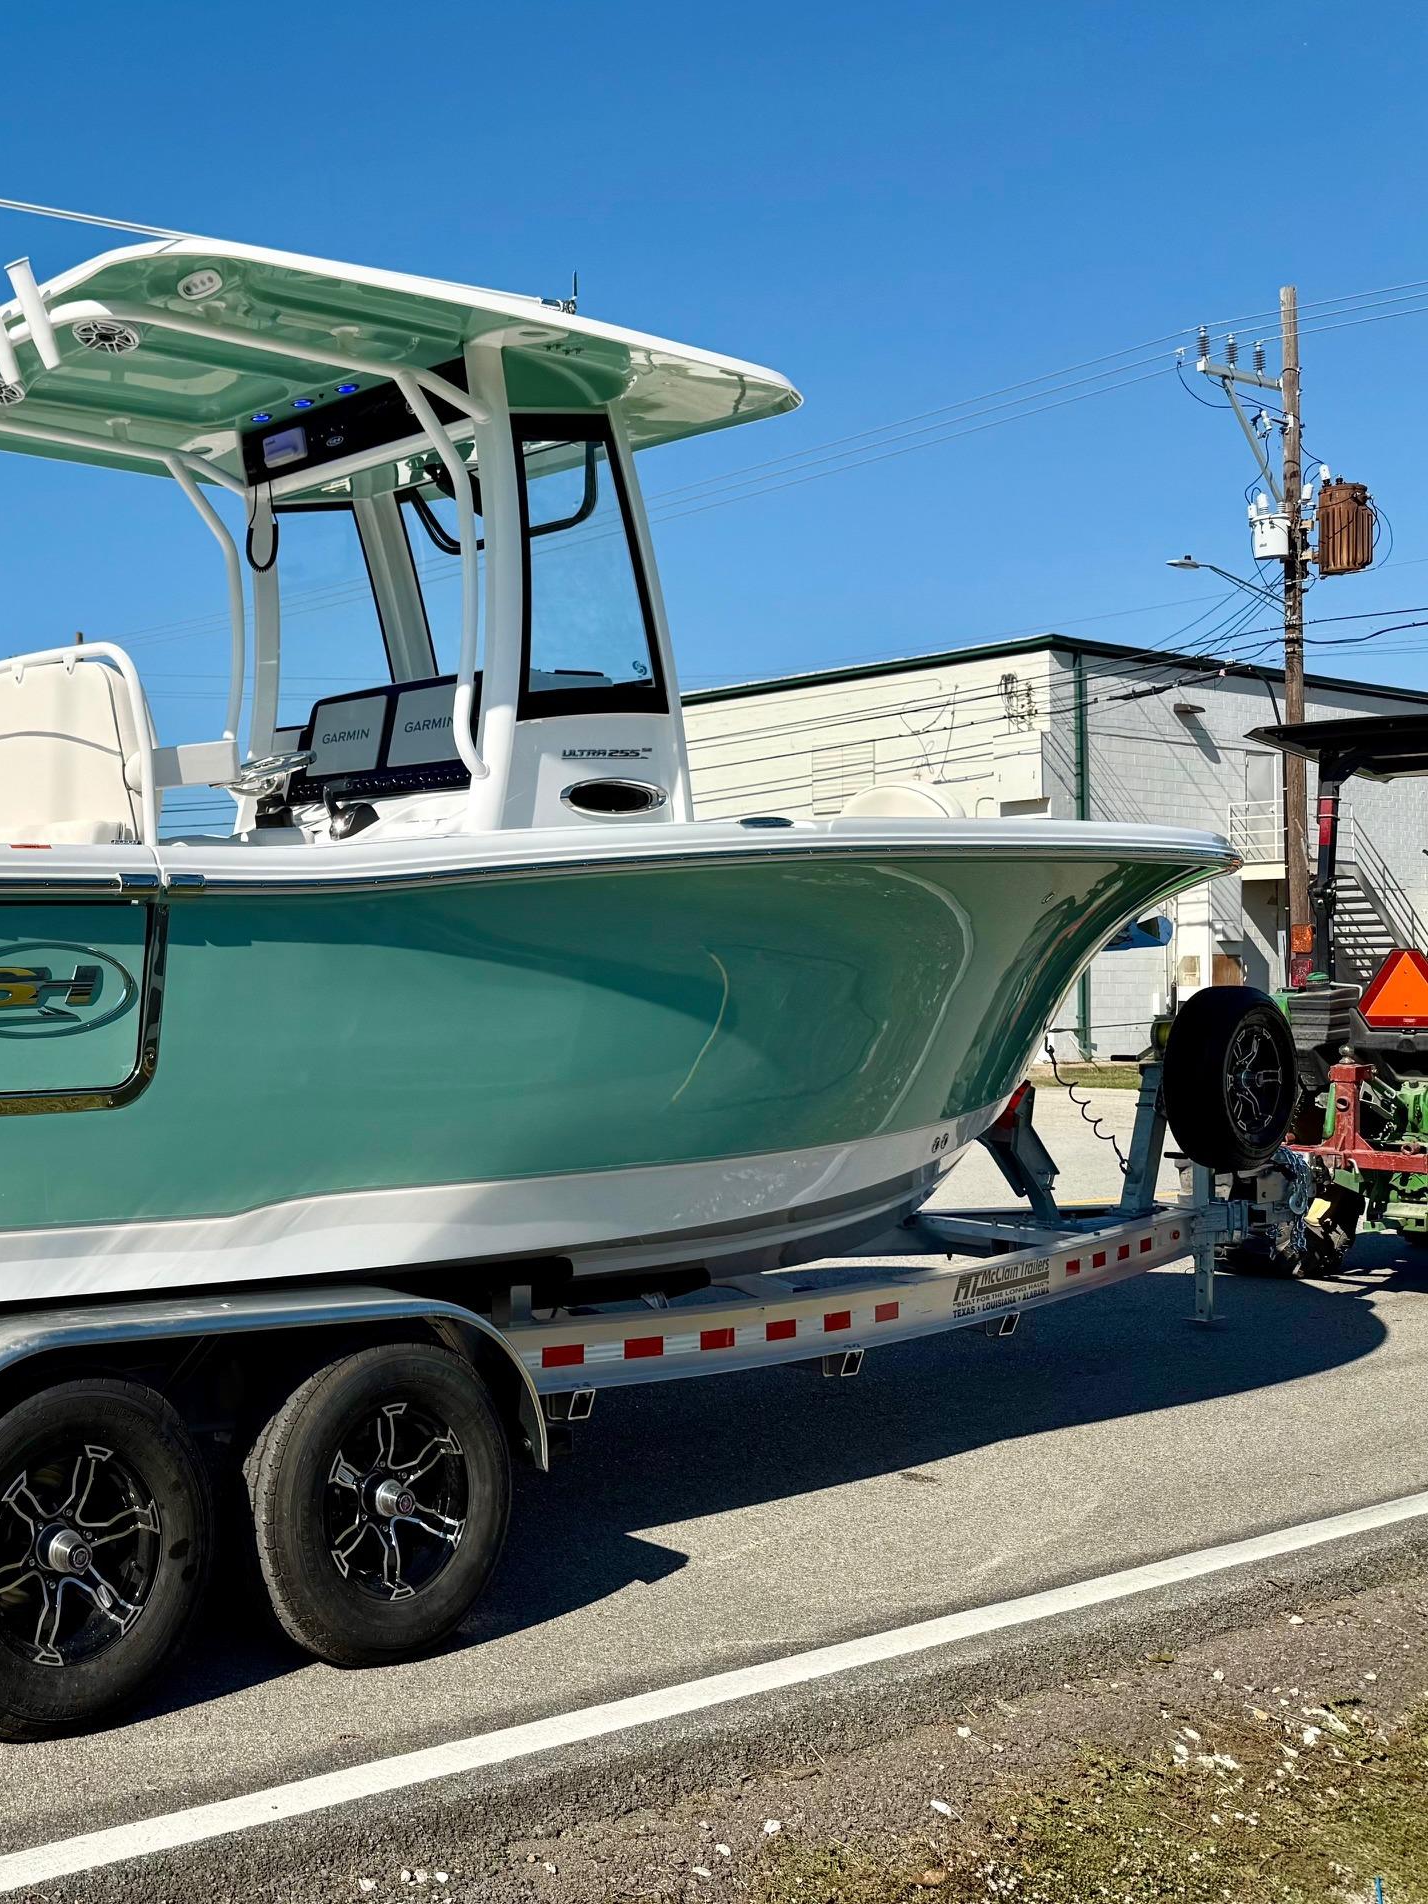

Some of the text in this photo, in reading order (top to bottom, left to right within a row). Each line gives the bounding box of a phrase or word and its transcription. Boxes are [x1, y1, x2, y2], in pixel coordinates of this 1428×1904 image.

[404, 716, 453, 733] GARMIN
[322, 728, 370, 745] GARMIN
[980, 1258, 1050, 1287] McClain Trailers
[952, 1287, 1050, 1318] TEXAS LOUISIANA ALABAMA
[976, 1295, 991, 1304] FOR
[992, 1291, 1004, 1299] THE
[1005, 1286, 1027, 1296] LONG
